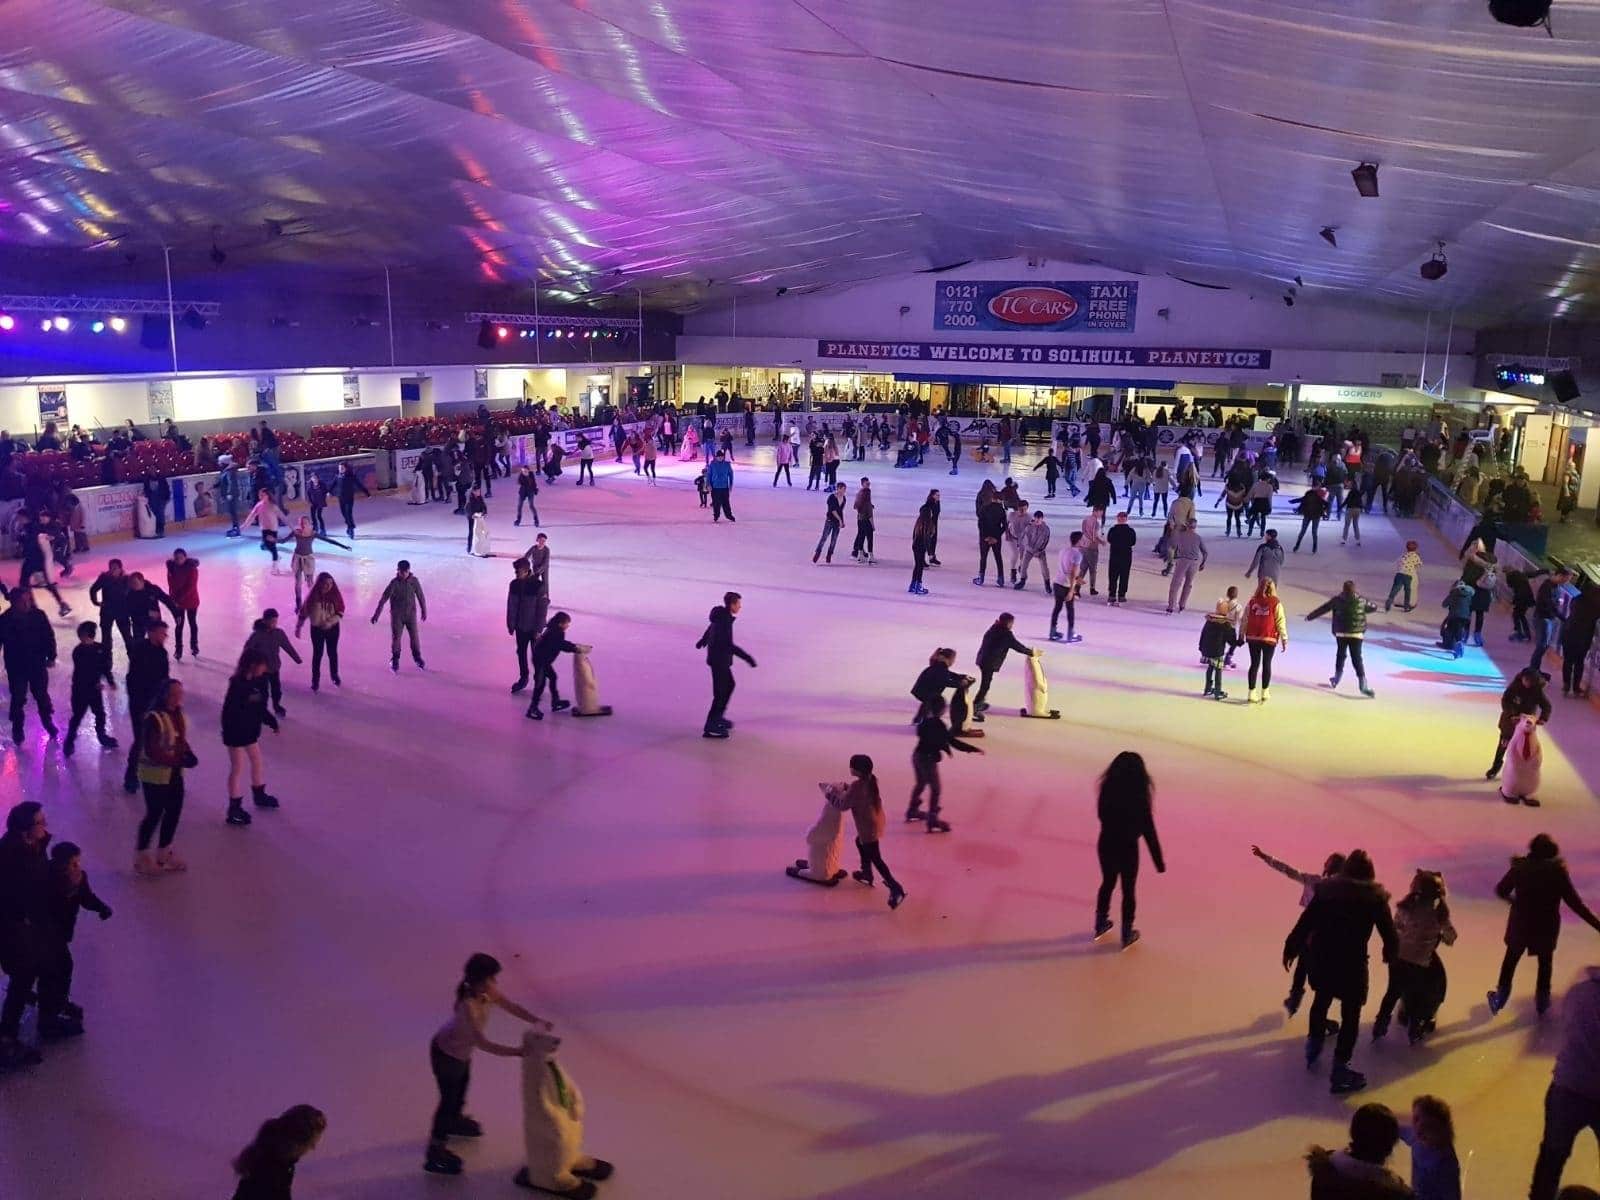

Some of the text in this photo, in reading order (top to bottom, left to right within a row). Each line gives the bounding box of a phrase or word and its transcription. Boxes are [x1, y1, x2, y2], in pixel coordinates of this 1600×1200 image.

[946, 285, 978, 298] 0121
[1090, 286, 1128, 298] TAXI
[948, 300, 973, 313] 770
[1001, 296, 1072, 314] TC CARS
[1089, 300, 1128, 311] FREE
[944, 314, 977, 326] 2000
[1088, 311, 1127, 320] PHONE
[929, 346, 1014, 361] WELCOME
[1021, 348, 1042, 362] TO
[1048, 349, 1135, 364] SOLIHULL
[1337, 390, 1383, 399] LOCKERS
